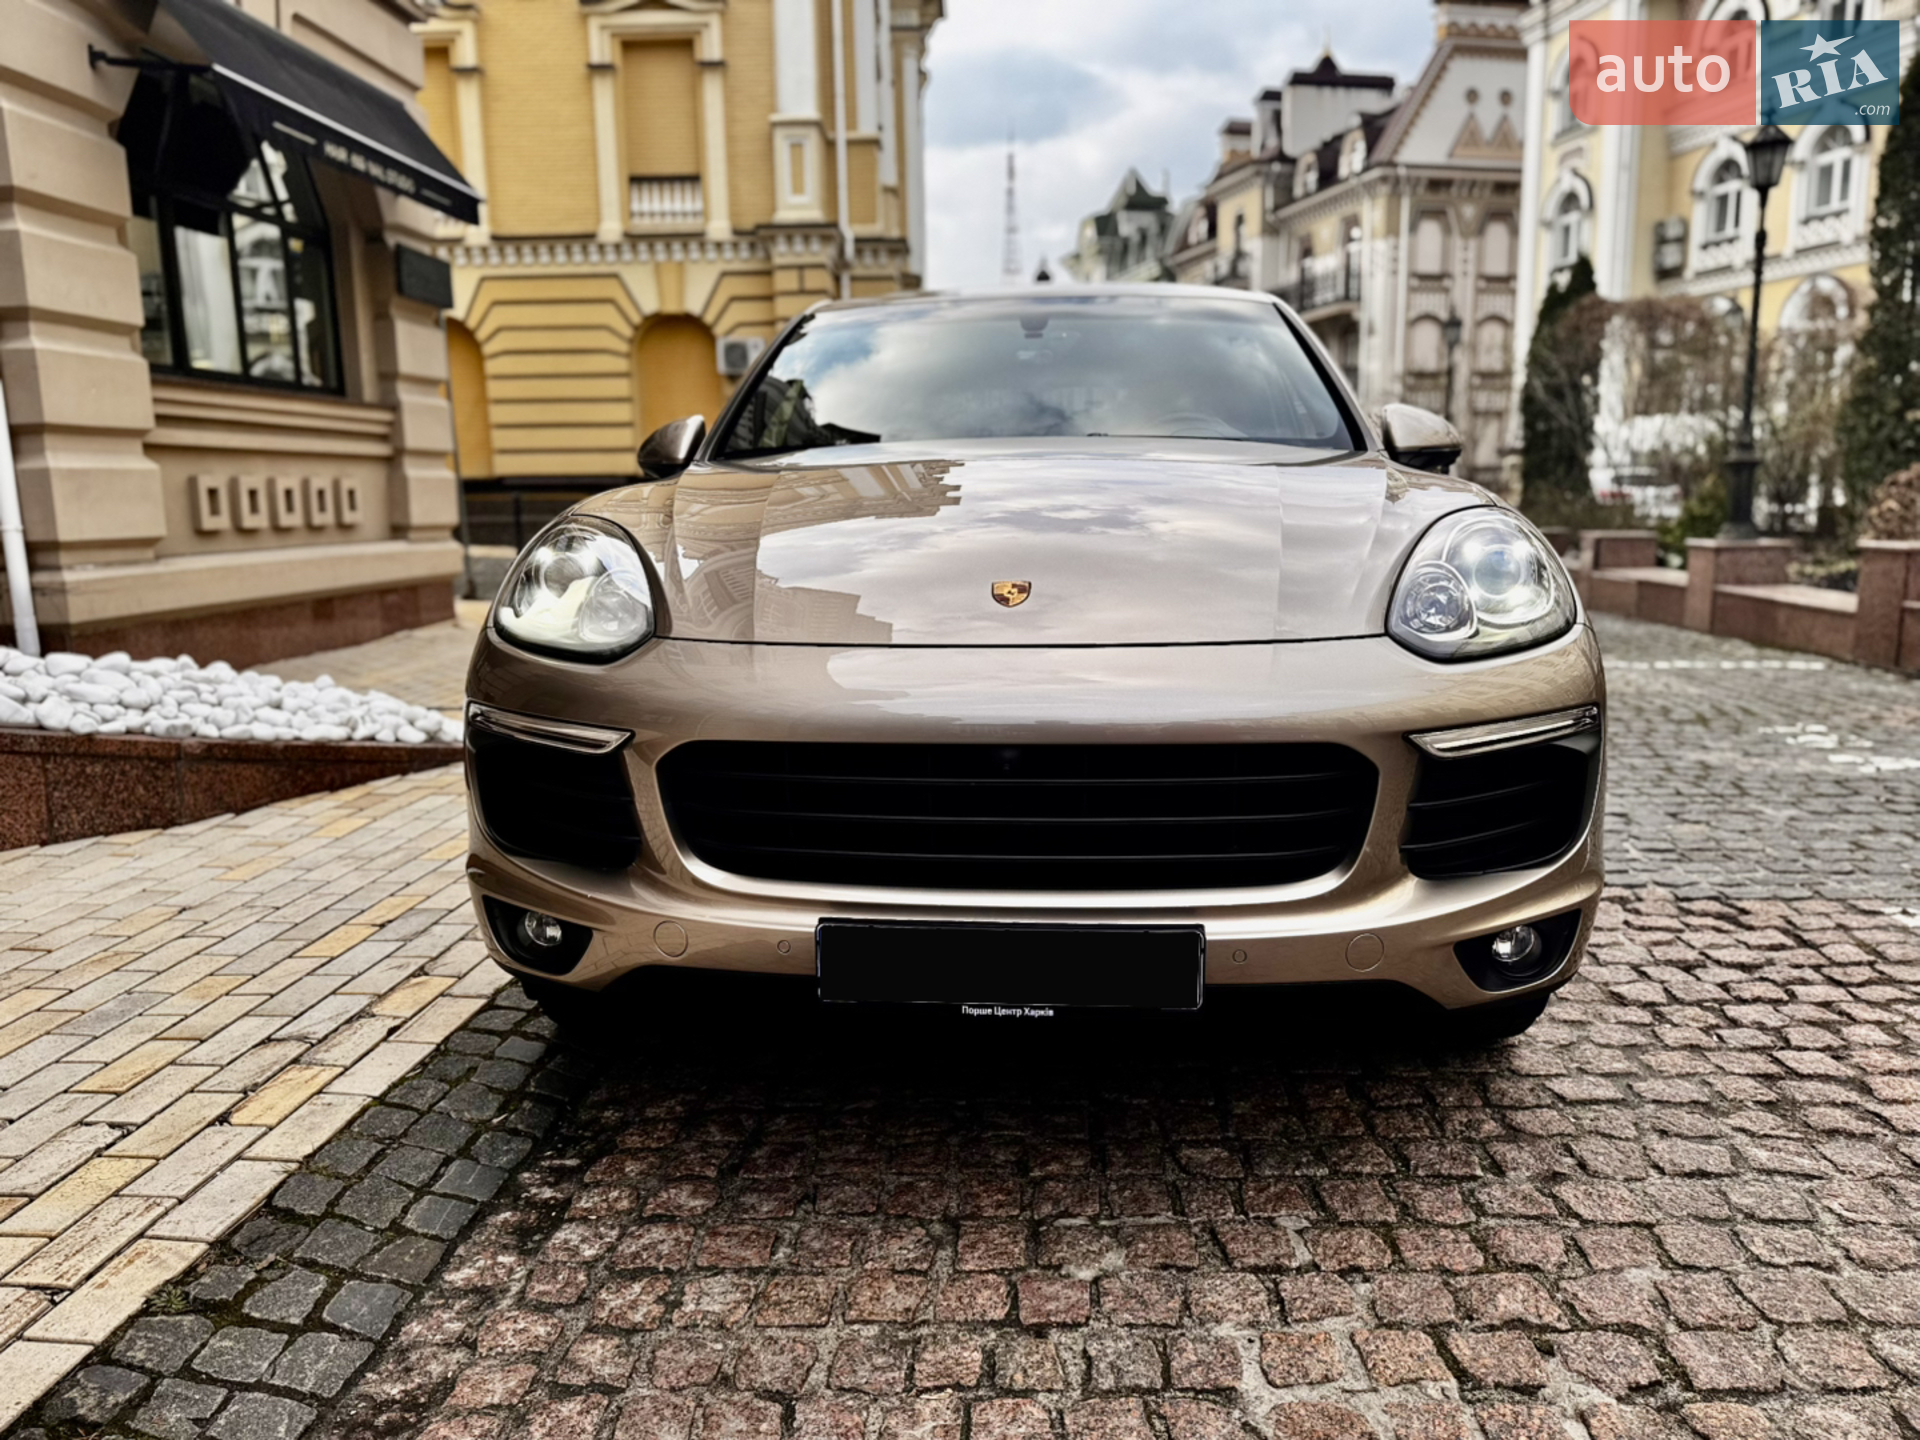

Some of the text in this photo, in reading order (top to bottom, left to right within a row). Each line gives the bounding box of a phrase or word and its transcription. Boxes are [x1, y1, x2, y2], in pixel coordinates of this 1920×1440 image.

[962, 1005, 1055, 1018] Порше Центр Харків
